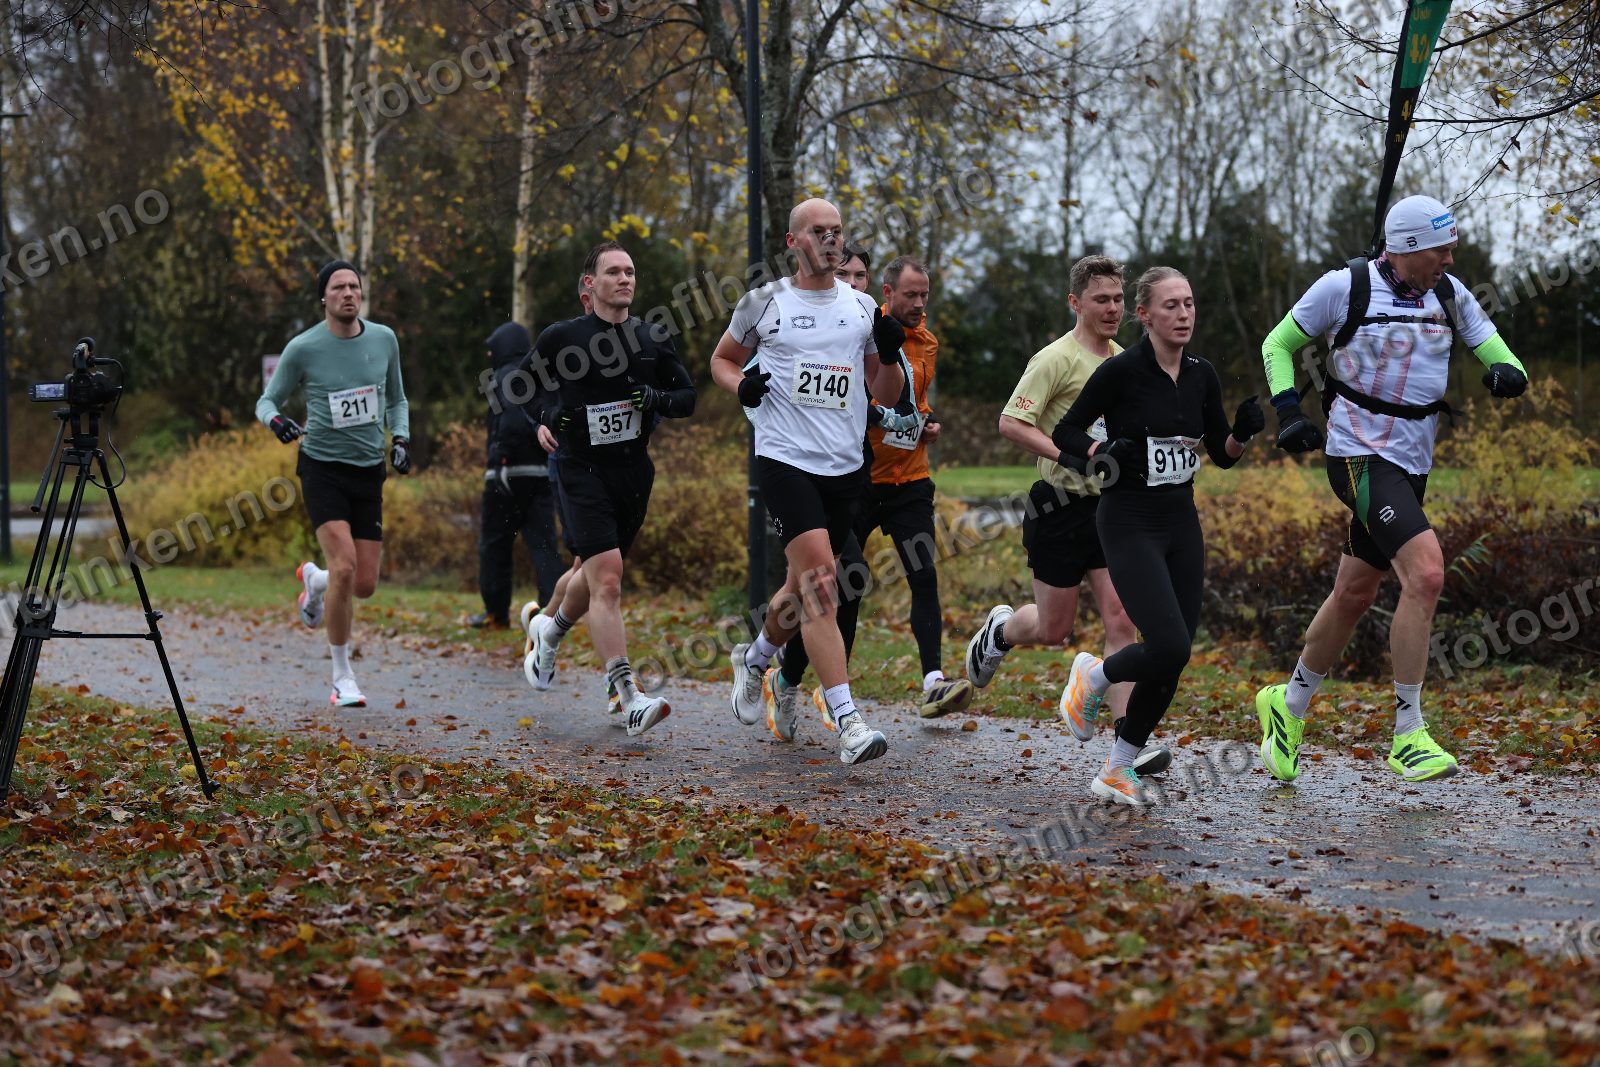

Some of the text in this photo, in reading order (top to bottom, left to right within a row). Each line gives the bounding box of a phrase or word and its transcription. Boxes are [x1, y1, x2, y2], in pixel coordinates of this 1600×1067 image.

[798, 371, 849, 399] 2140
[341, 396, 368, 418] 211
[599, 410, 633, 435] 357
